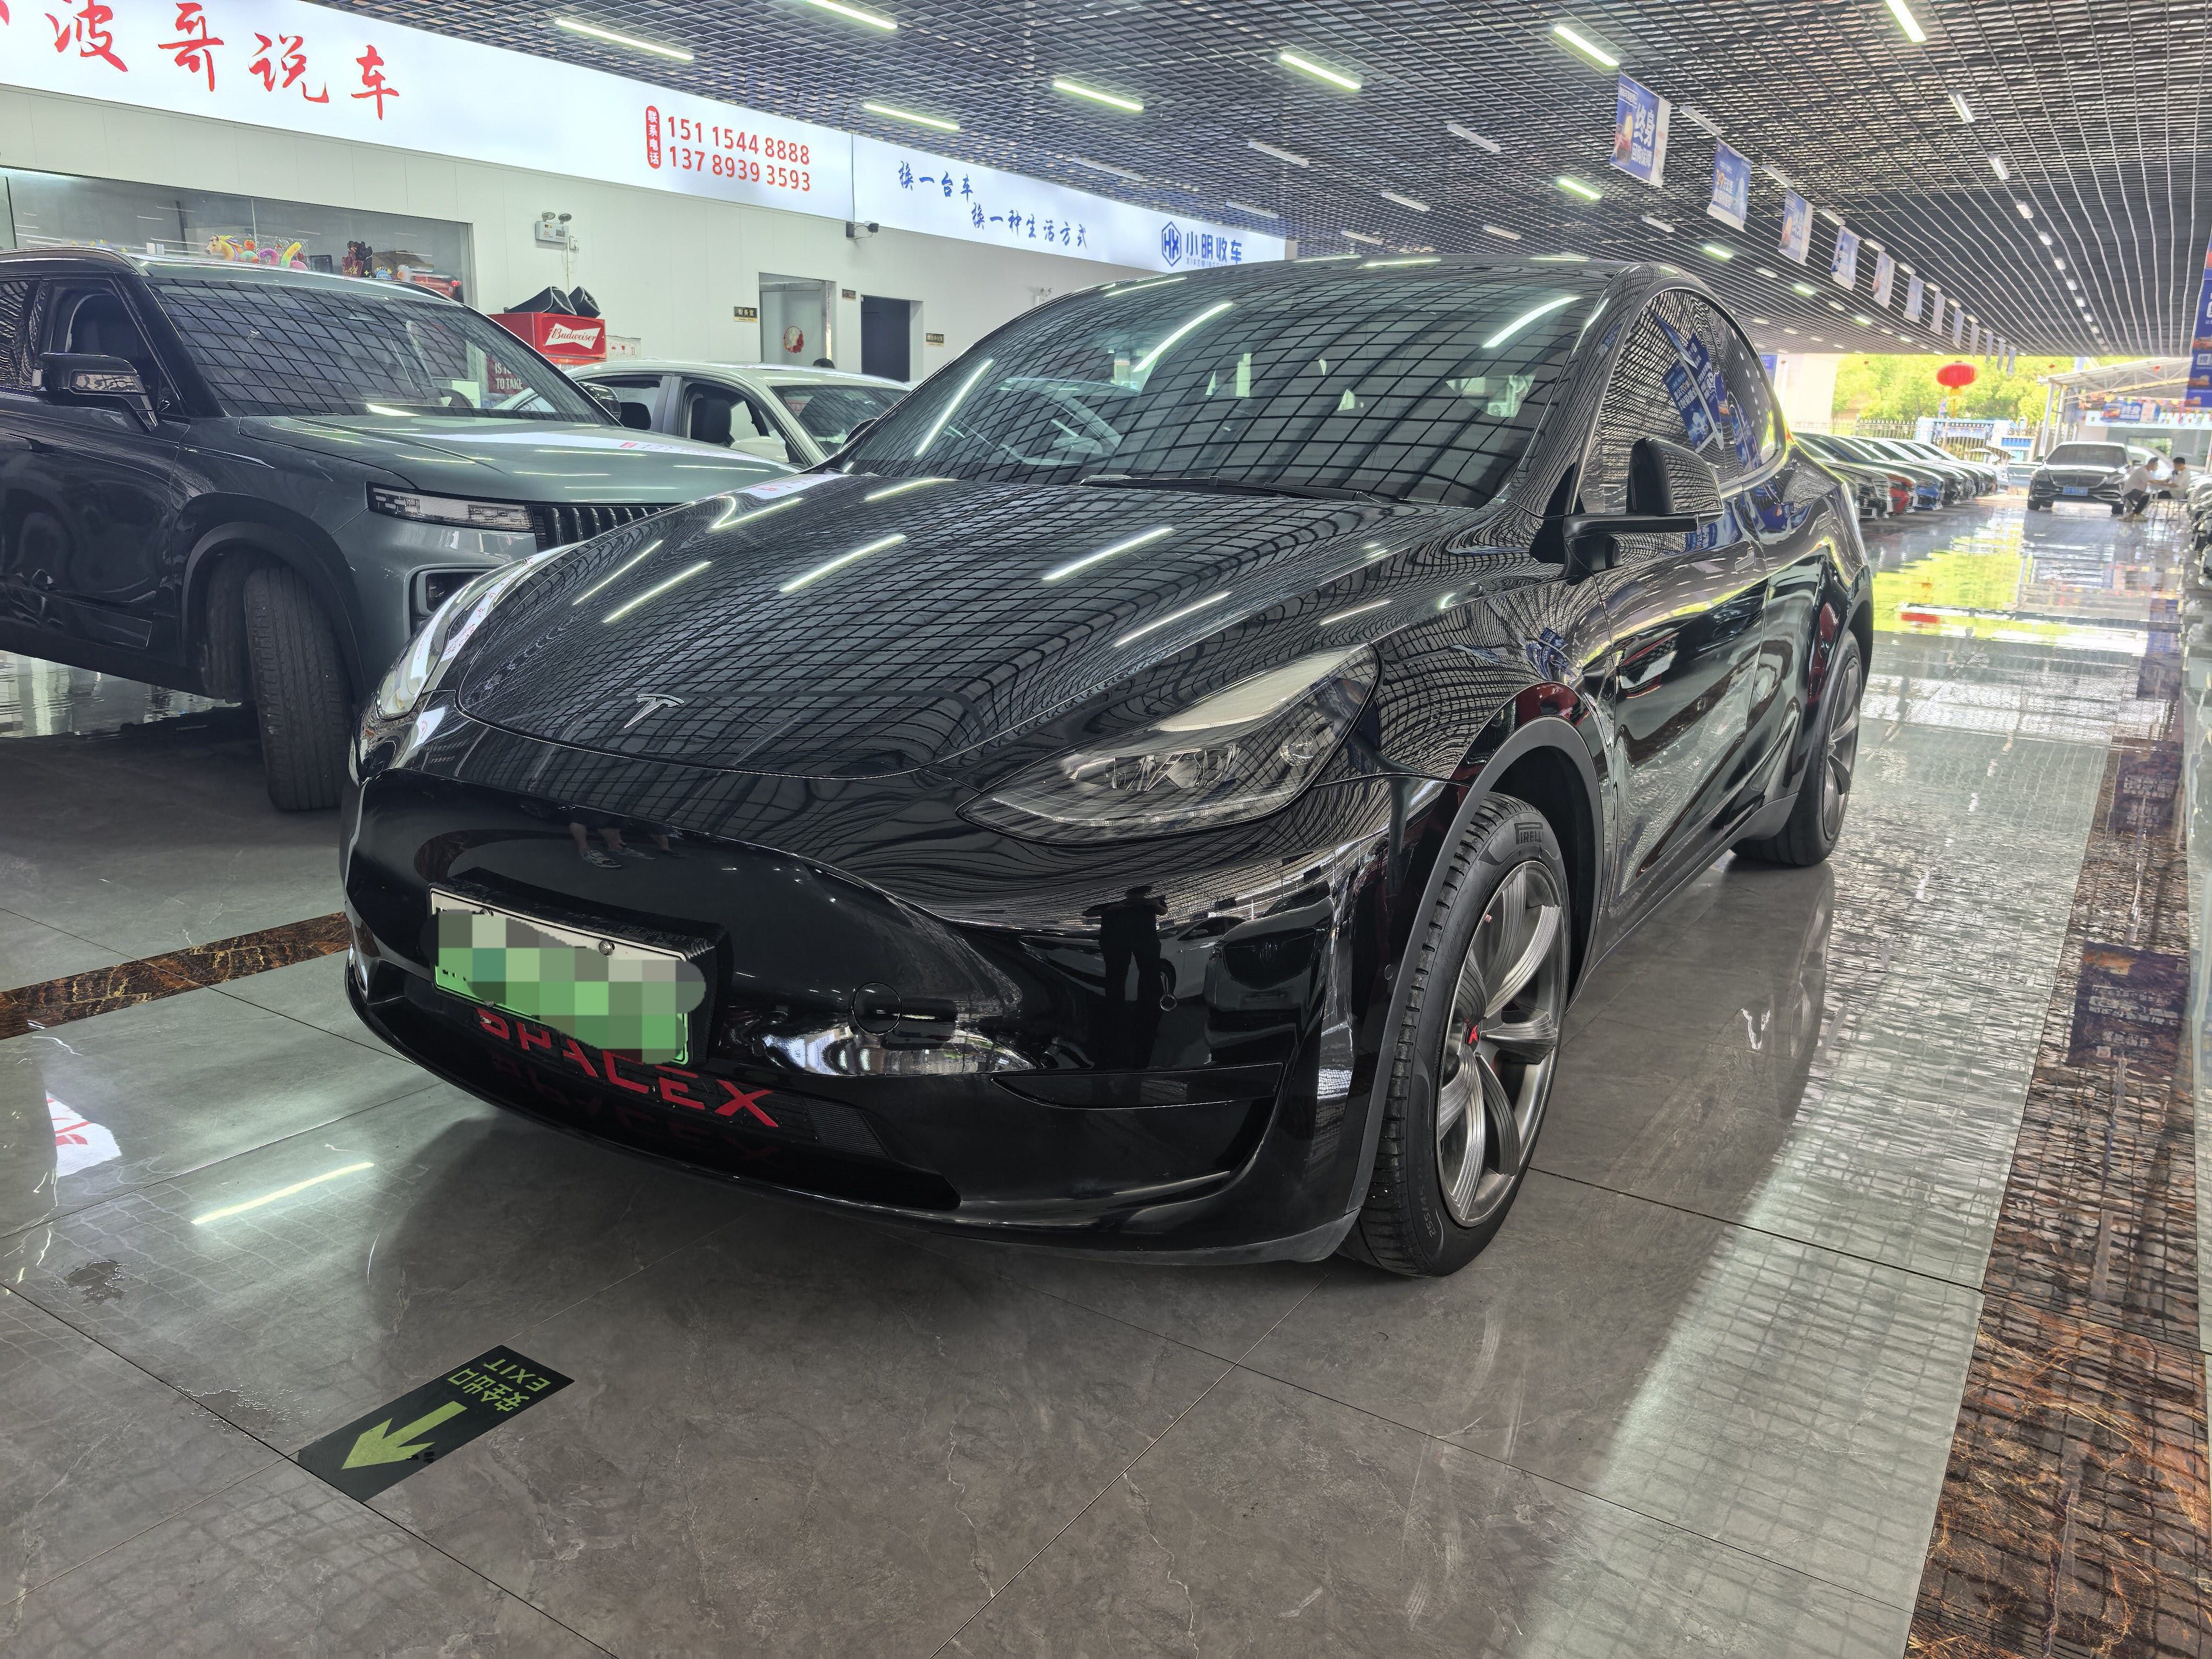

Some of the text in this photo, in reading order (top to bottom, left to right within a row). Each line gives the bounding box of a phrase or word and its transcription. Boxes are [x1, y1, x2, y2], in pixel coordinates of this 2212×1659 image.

[0, 0, 400, 121] 波哥说车
[648, 110, 659, 165] 联系电话
[668, 116, 810, 165] 151 1544 8888
[670, 146, 810, 192] 137 8939 3593
[1185, 231, 1242, 265] 小明收车
[550, 327, 597, 342] Budweiser
[496, 377, 505, 389] TO
[447, 1367, 530, 1412] 安全出口
[483, 1358, 552, 1392] EXIT
